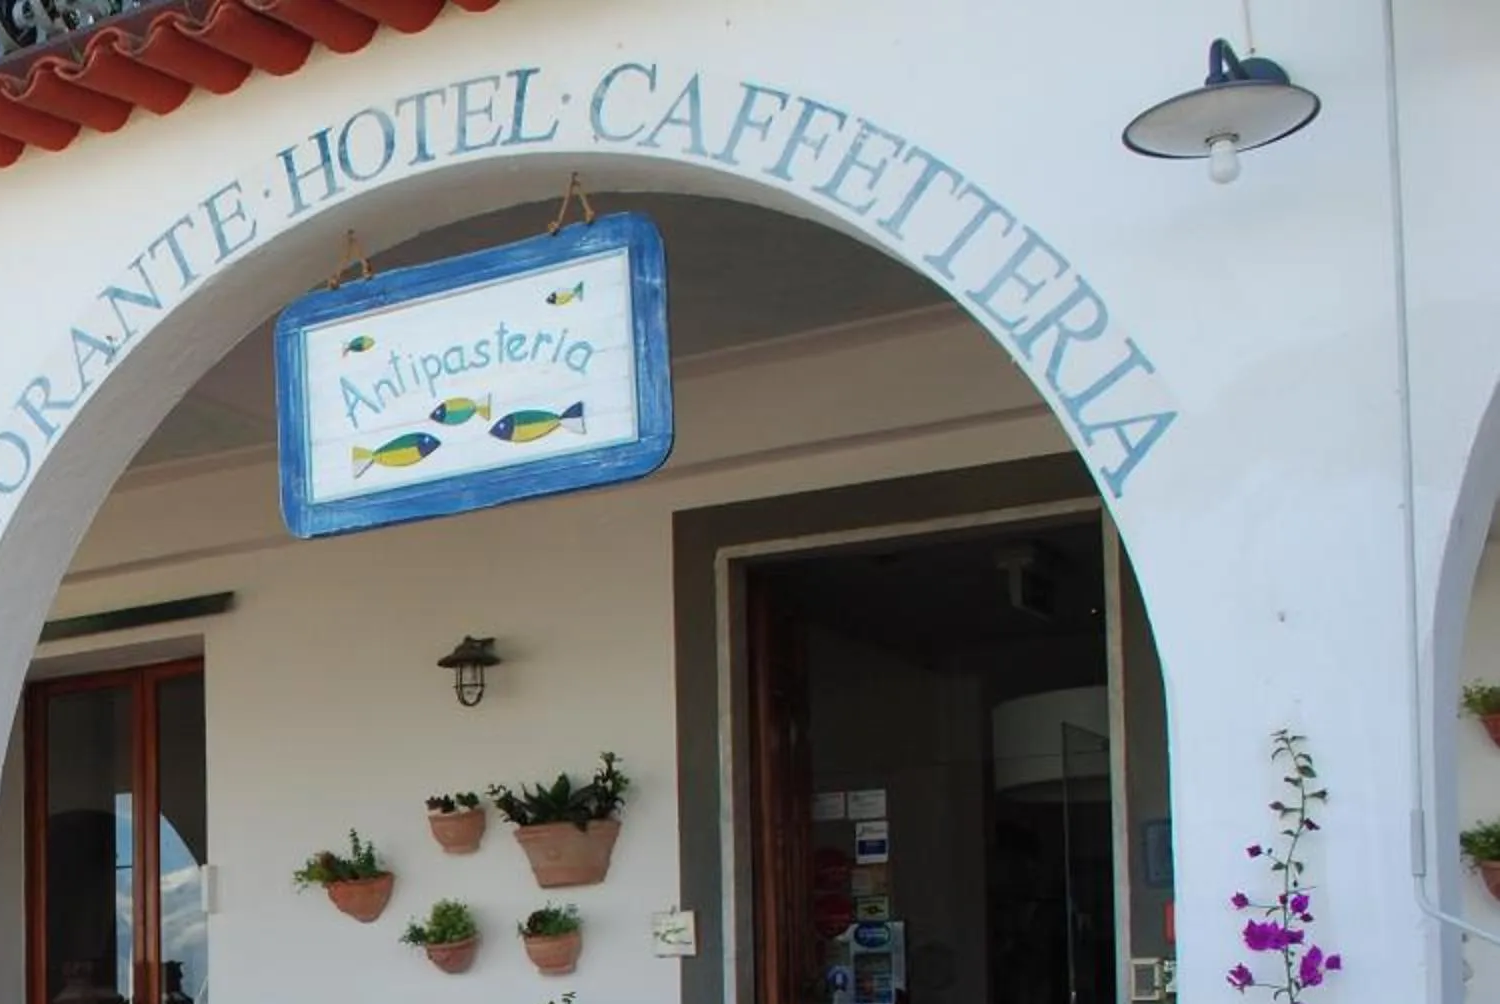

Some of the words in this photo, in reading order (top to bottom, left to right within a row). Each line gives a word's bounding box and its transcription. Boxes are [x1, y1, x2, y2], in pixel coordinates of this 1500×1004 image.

[276, 67, 559, 219] HOTEL
[589, 62, 1178, 499] CAFFETTERIA
[339, 321, 595, 429] Antipasteria
